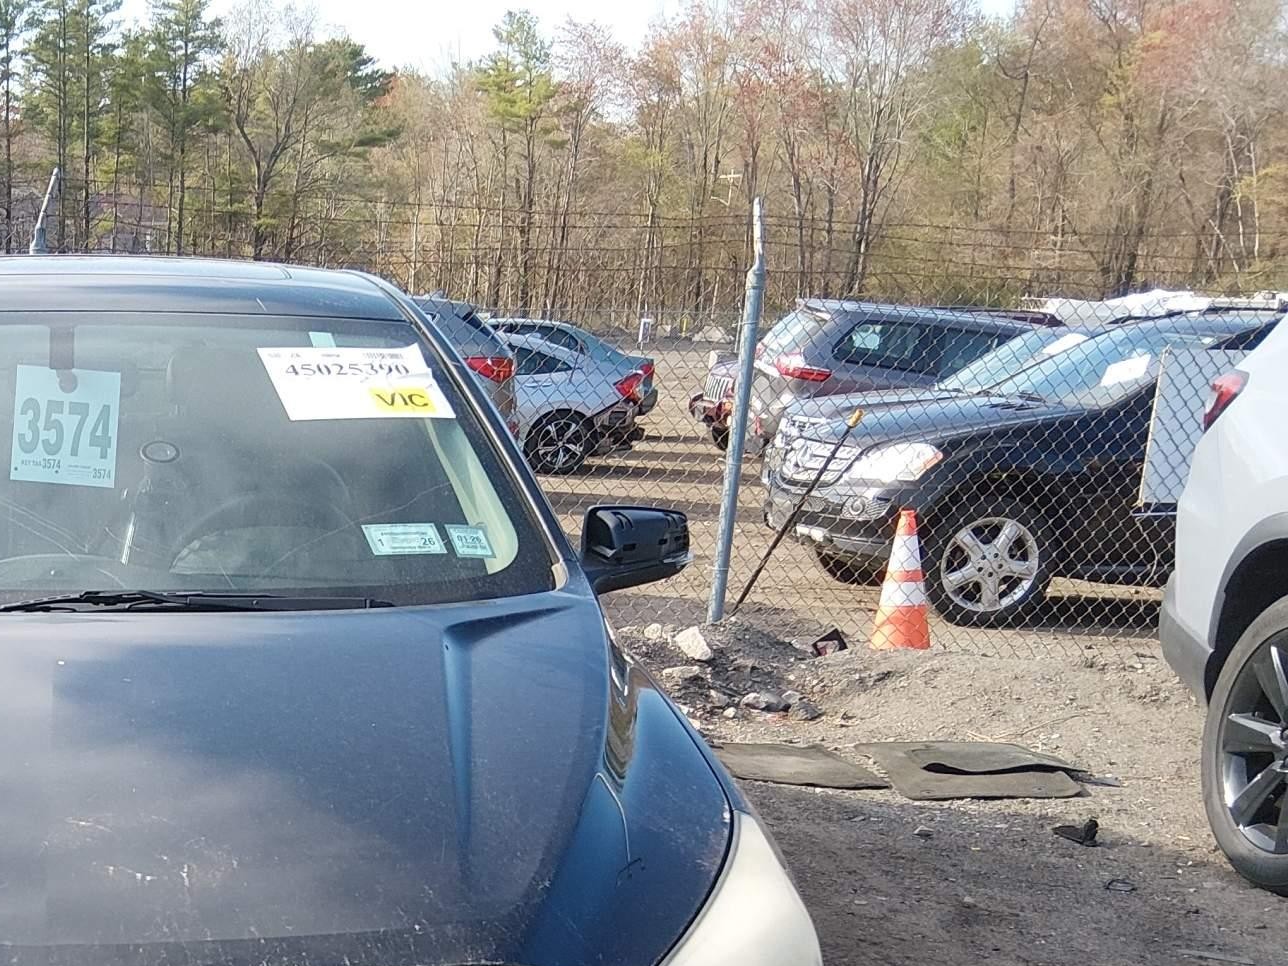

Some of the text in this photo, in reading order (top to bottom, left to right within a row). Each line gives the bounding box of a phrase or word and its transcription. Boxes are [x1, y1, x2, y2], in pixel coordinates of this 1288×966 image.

[285, 363, 410, 377] 45025390
[375, 392, 430, 408] VIC
[17, 397, 112, 460] 3574
[42, 458, 61, 470] 3574
[92, 468, 111, 480] 3574
